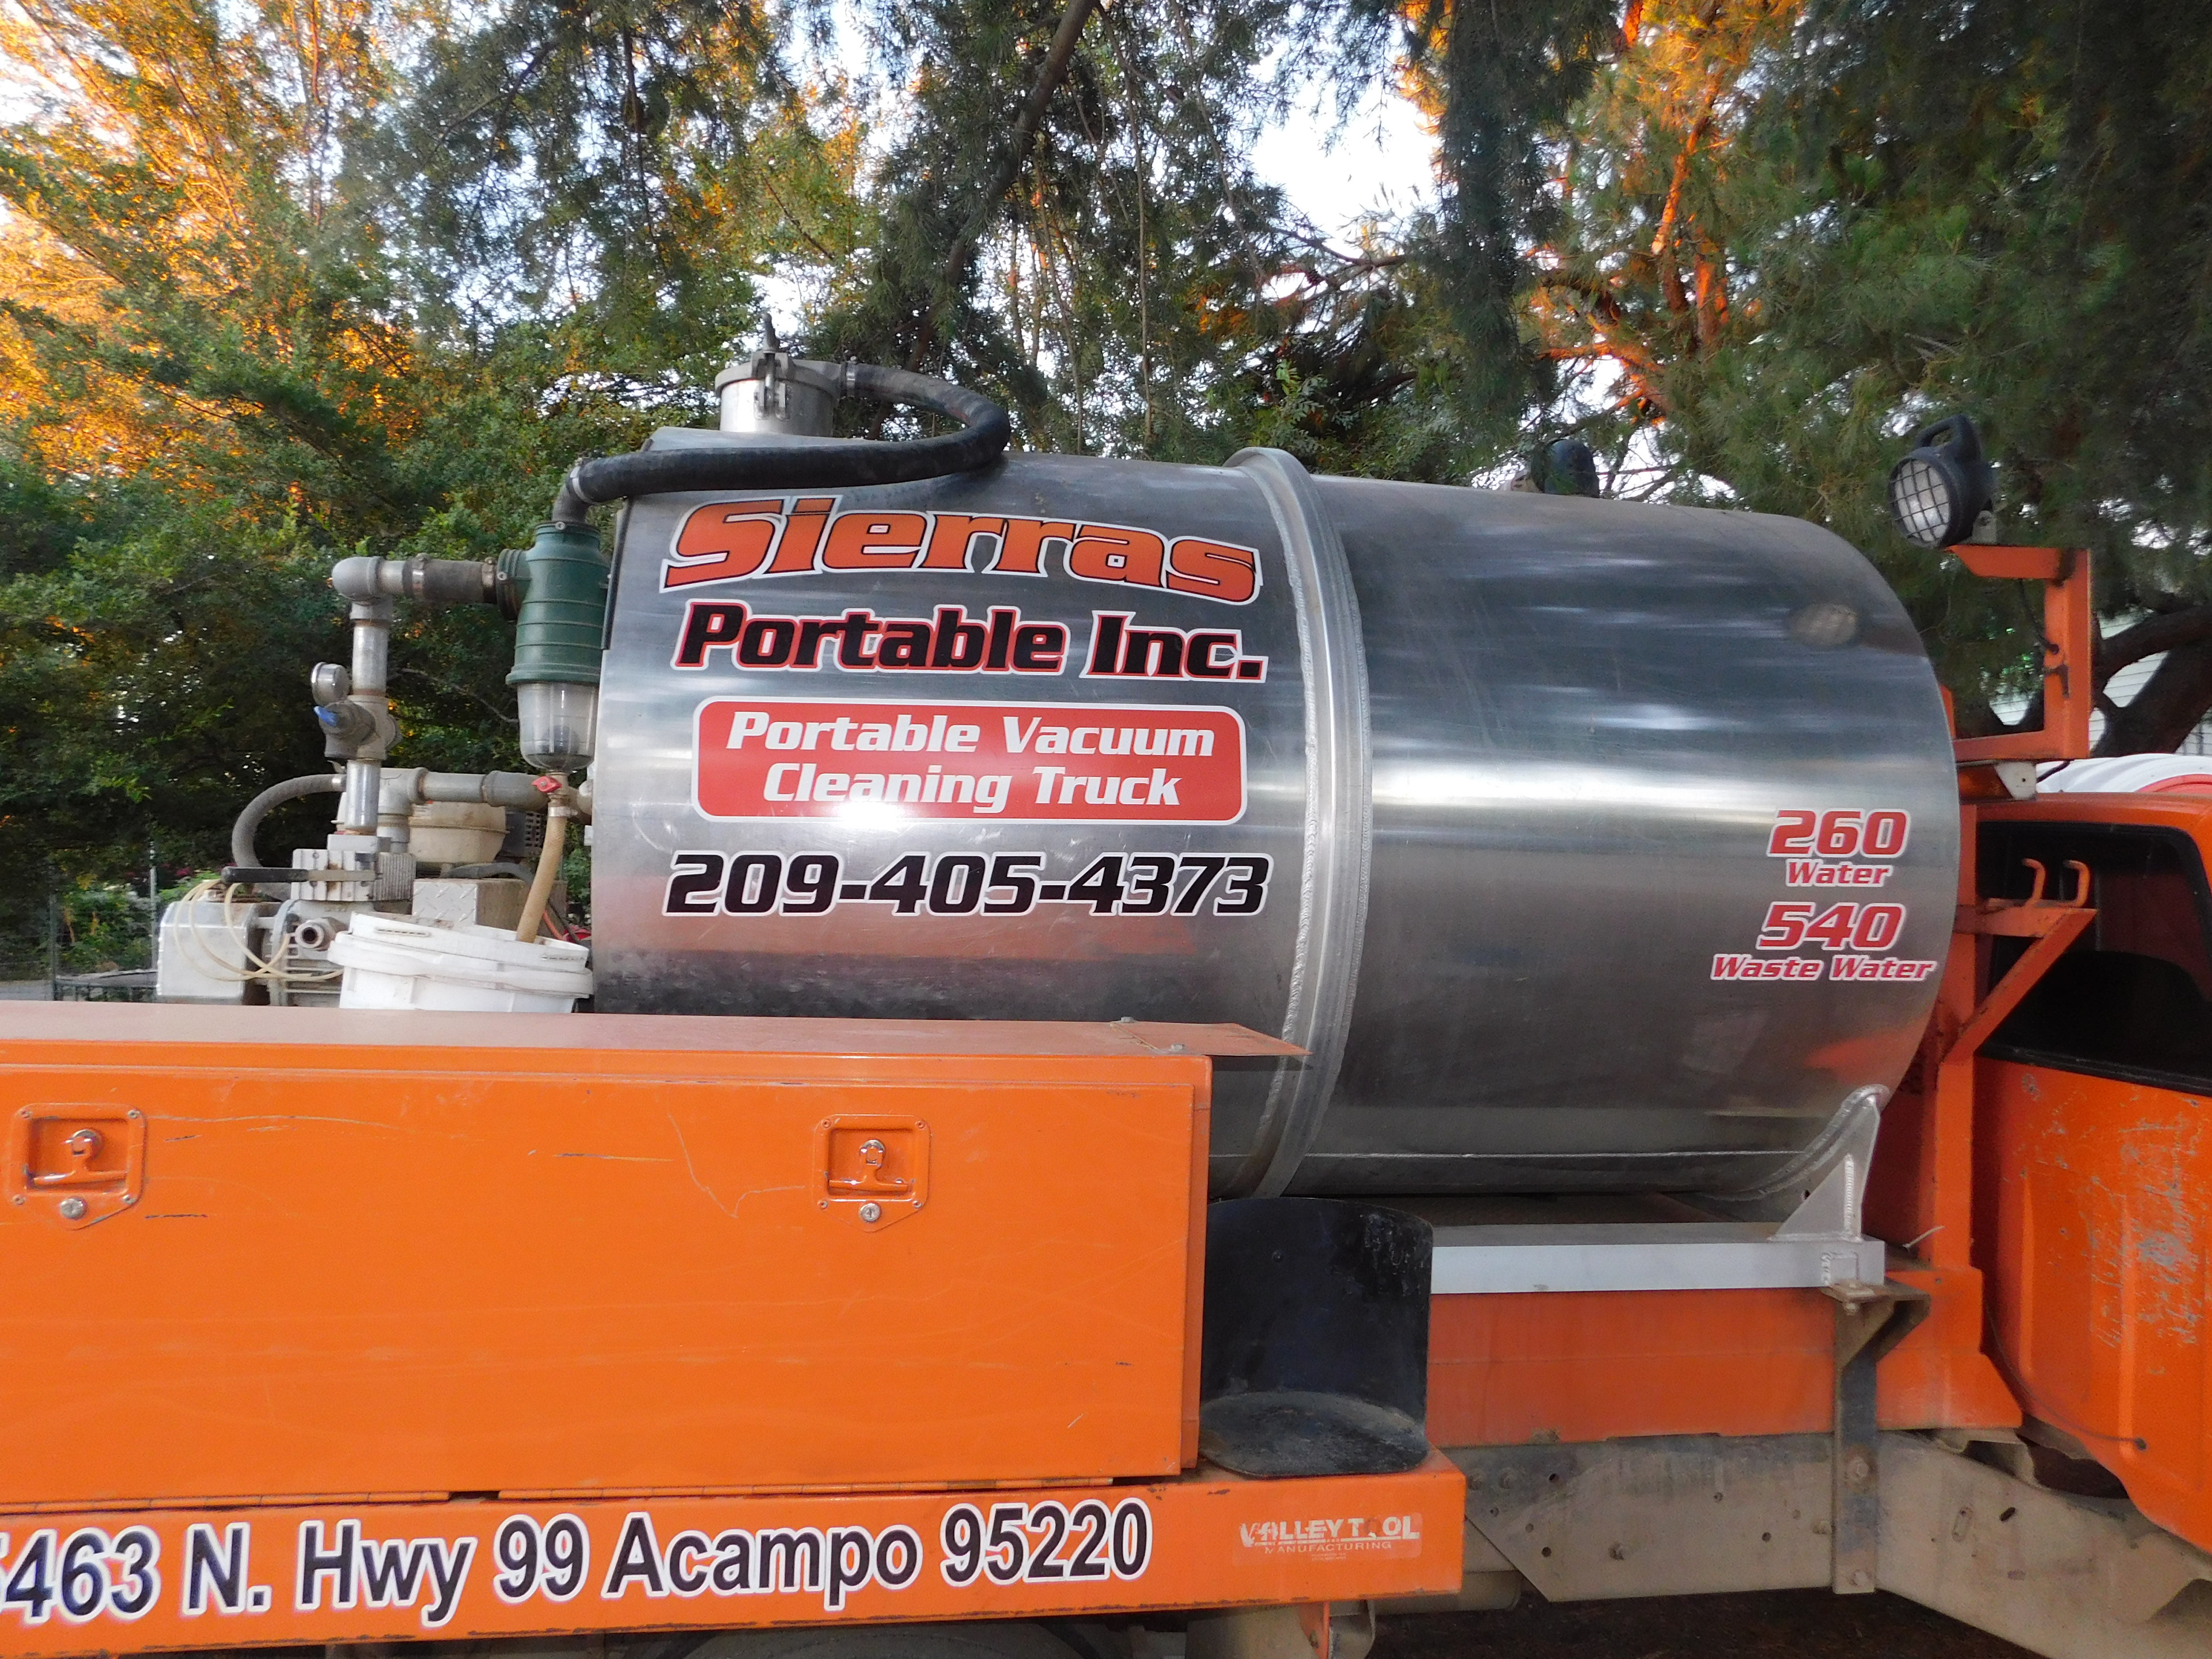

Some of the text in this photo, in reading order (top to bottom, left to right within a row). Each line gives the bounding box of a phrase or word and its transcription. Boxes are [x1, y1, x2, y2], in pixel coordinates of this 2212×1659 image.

[660, 497, 1262, 604] Sierras
[671, 599, 1268, 683] Portable Inc.
[726, 712, 1214, 756] Portable Vacuum
[763, 763, 1181, 813] Cleaning Truck
[1767, 808, 1911, 858] 260
[662, 851, 1274, 917] 209-405-4373
[1786, 858, 1893, 887] Water
[1756, 901, 1906, 950] 540
[1710, 954, 1938, 981] Waste Water
[1348, 1516, 1420, 1540] TOL
[0, 1497, 1153, 1627] 463 N. Hwy 99 Acampo 95220
